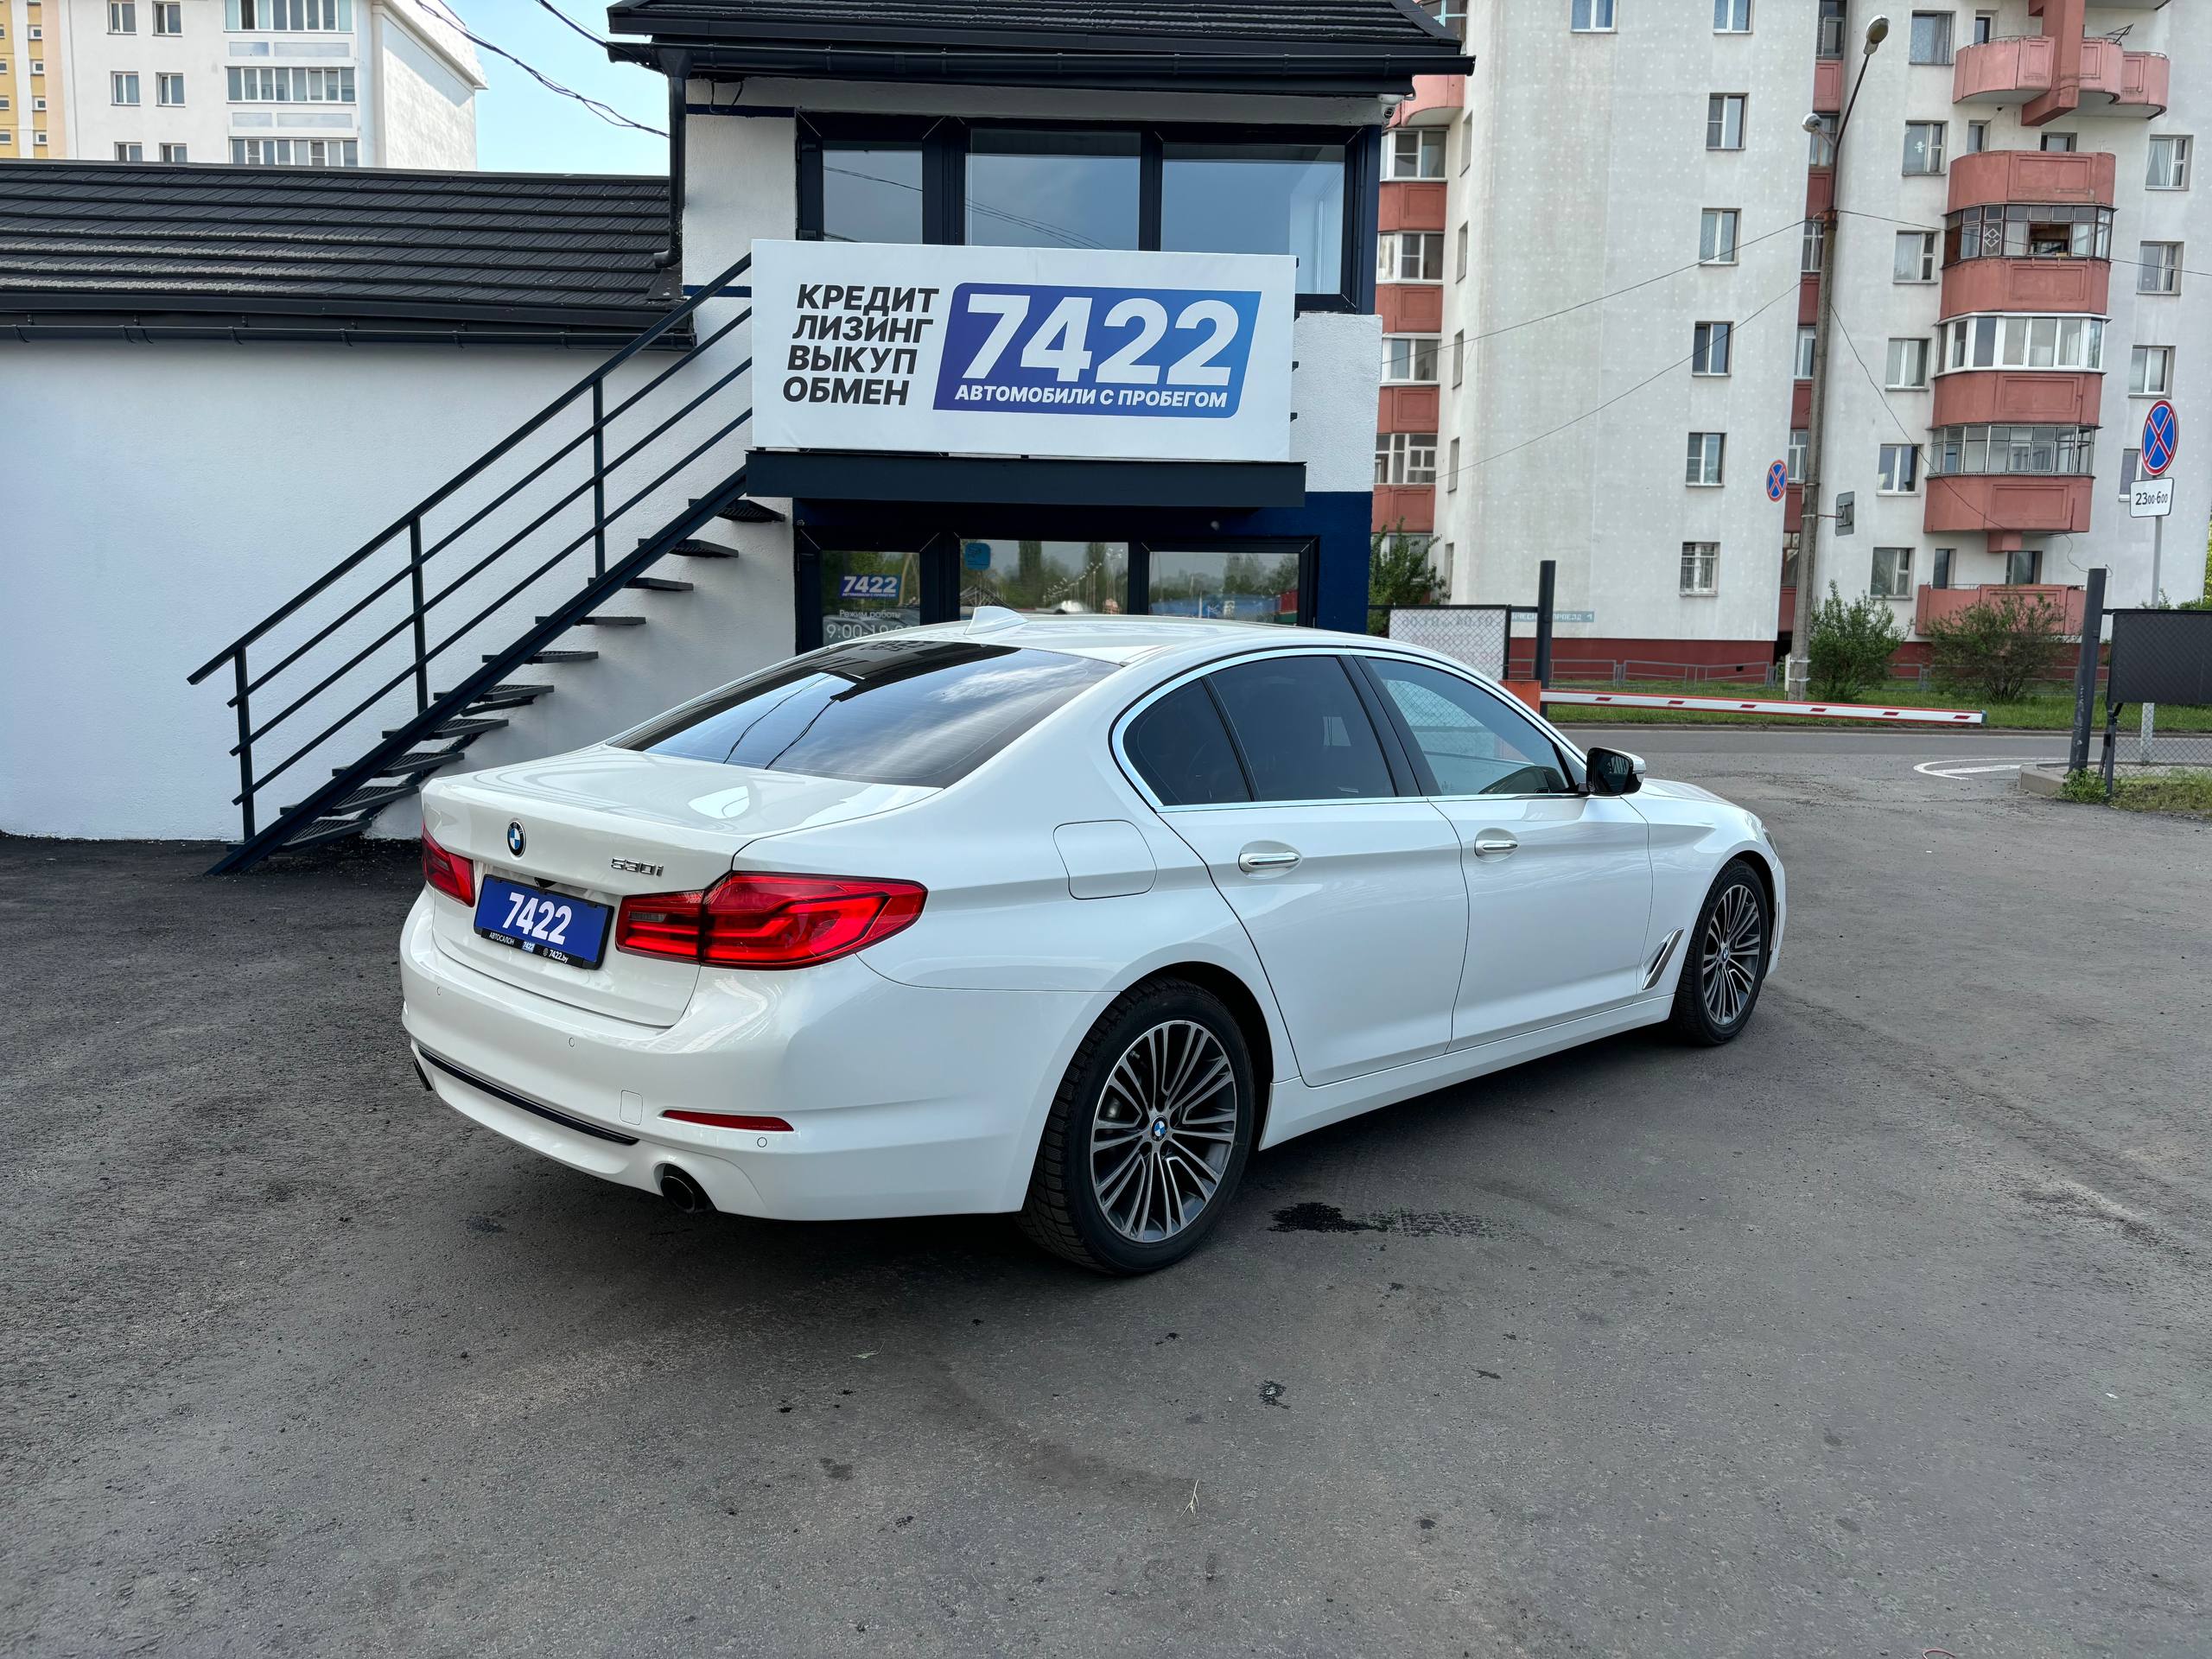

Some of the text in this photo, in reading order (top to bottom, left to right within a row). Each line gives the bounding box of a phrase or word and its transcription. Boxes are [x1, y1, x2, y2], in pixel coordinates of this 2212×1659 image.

[796, 283, 939, 317] КРЕДИТ
[792, 315, 934, 344] ЛИЗИНГ
[962, 294, 1240, 386] 7422
[787, 346, 918, 375] ВЫКУП
[782, 376, 909, 406] ОБМЕН
[955, 385, 1228, 409] АВТОМОБИЛИ С ПРОБЕГОМ
[843, 575, 898, 594] 7422
[839, 609, 901, 620] Режим работы
[611, 857, 664, 876] 530i
[502, 892, 572, 945] 7422
[488, 931, 569, 963] АВТОСАЛОН 7422 7422.by
